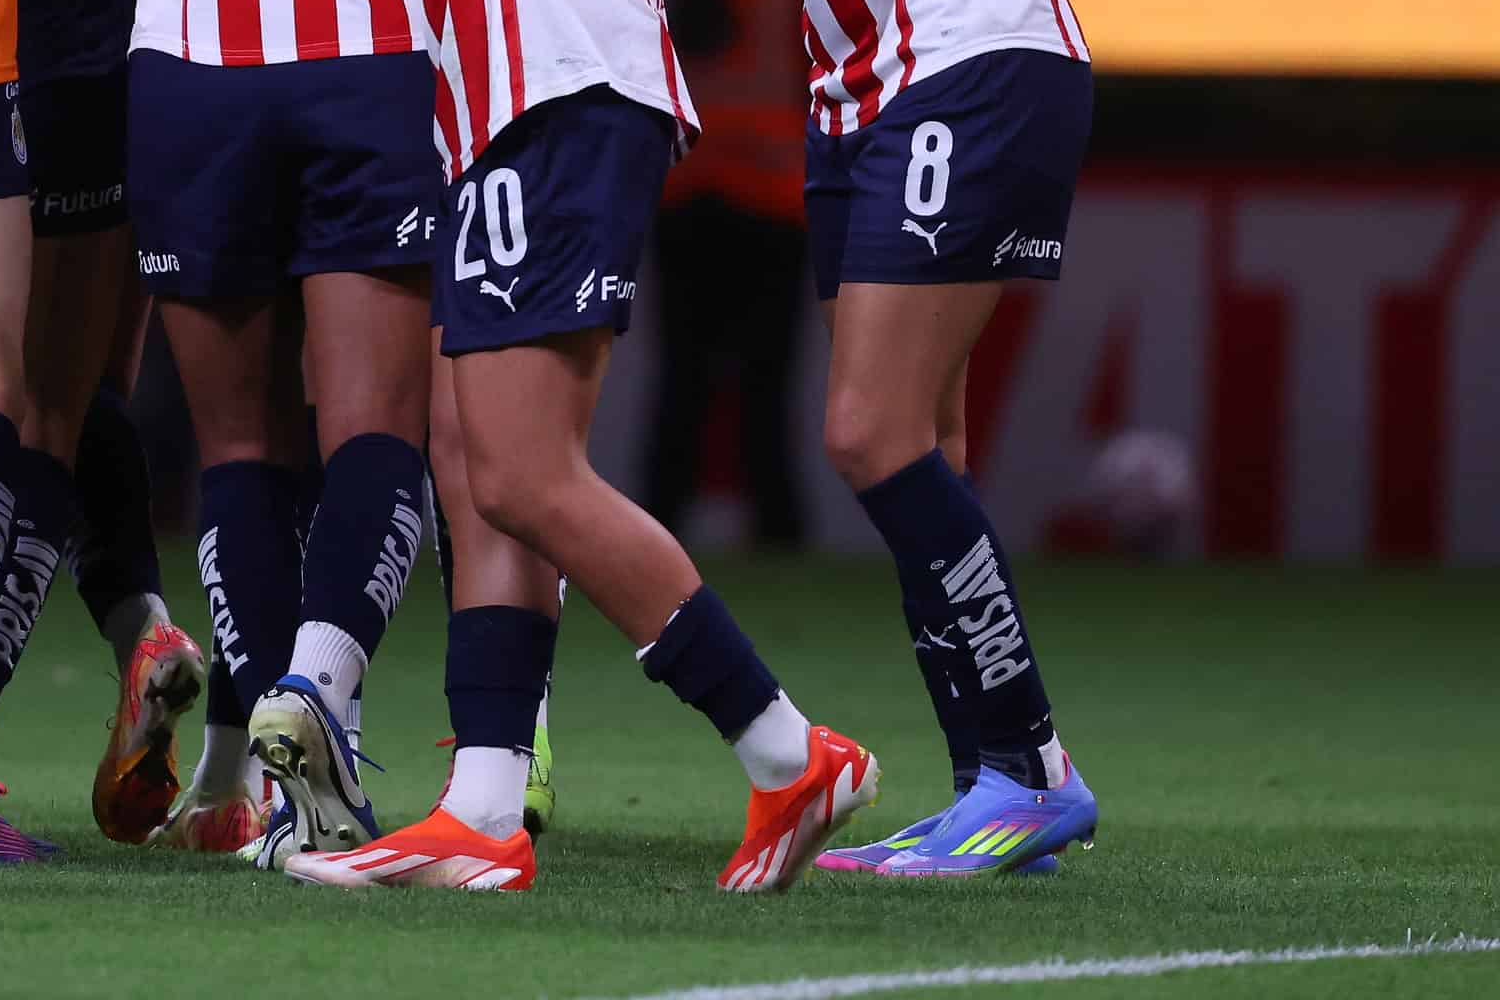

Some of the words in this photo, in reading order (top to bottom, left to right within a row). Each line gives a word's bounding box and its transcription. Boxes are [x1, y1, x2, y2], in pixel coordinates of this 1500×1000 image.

[43, 183, 123, 217] Futura
[905, 121, 954, 217] 8
[455, 167, 529, 282] 20
[1011, 236, 1062, 260] Futura
